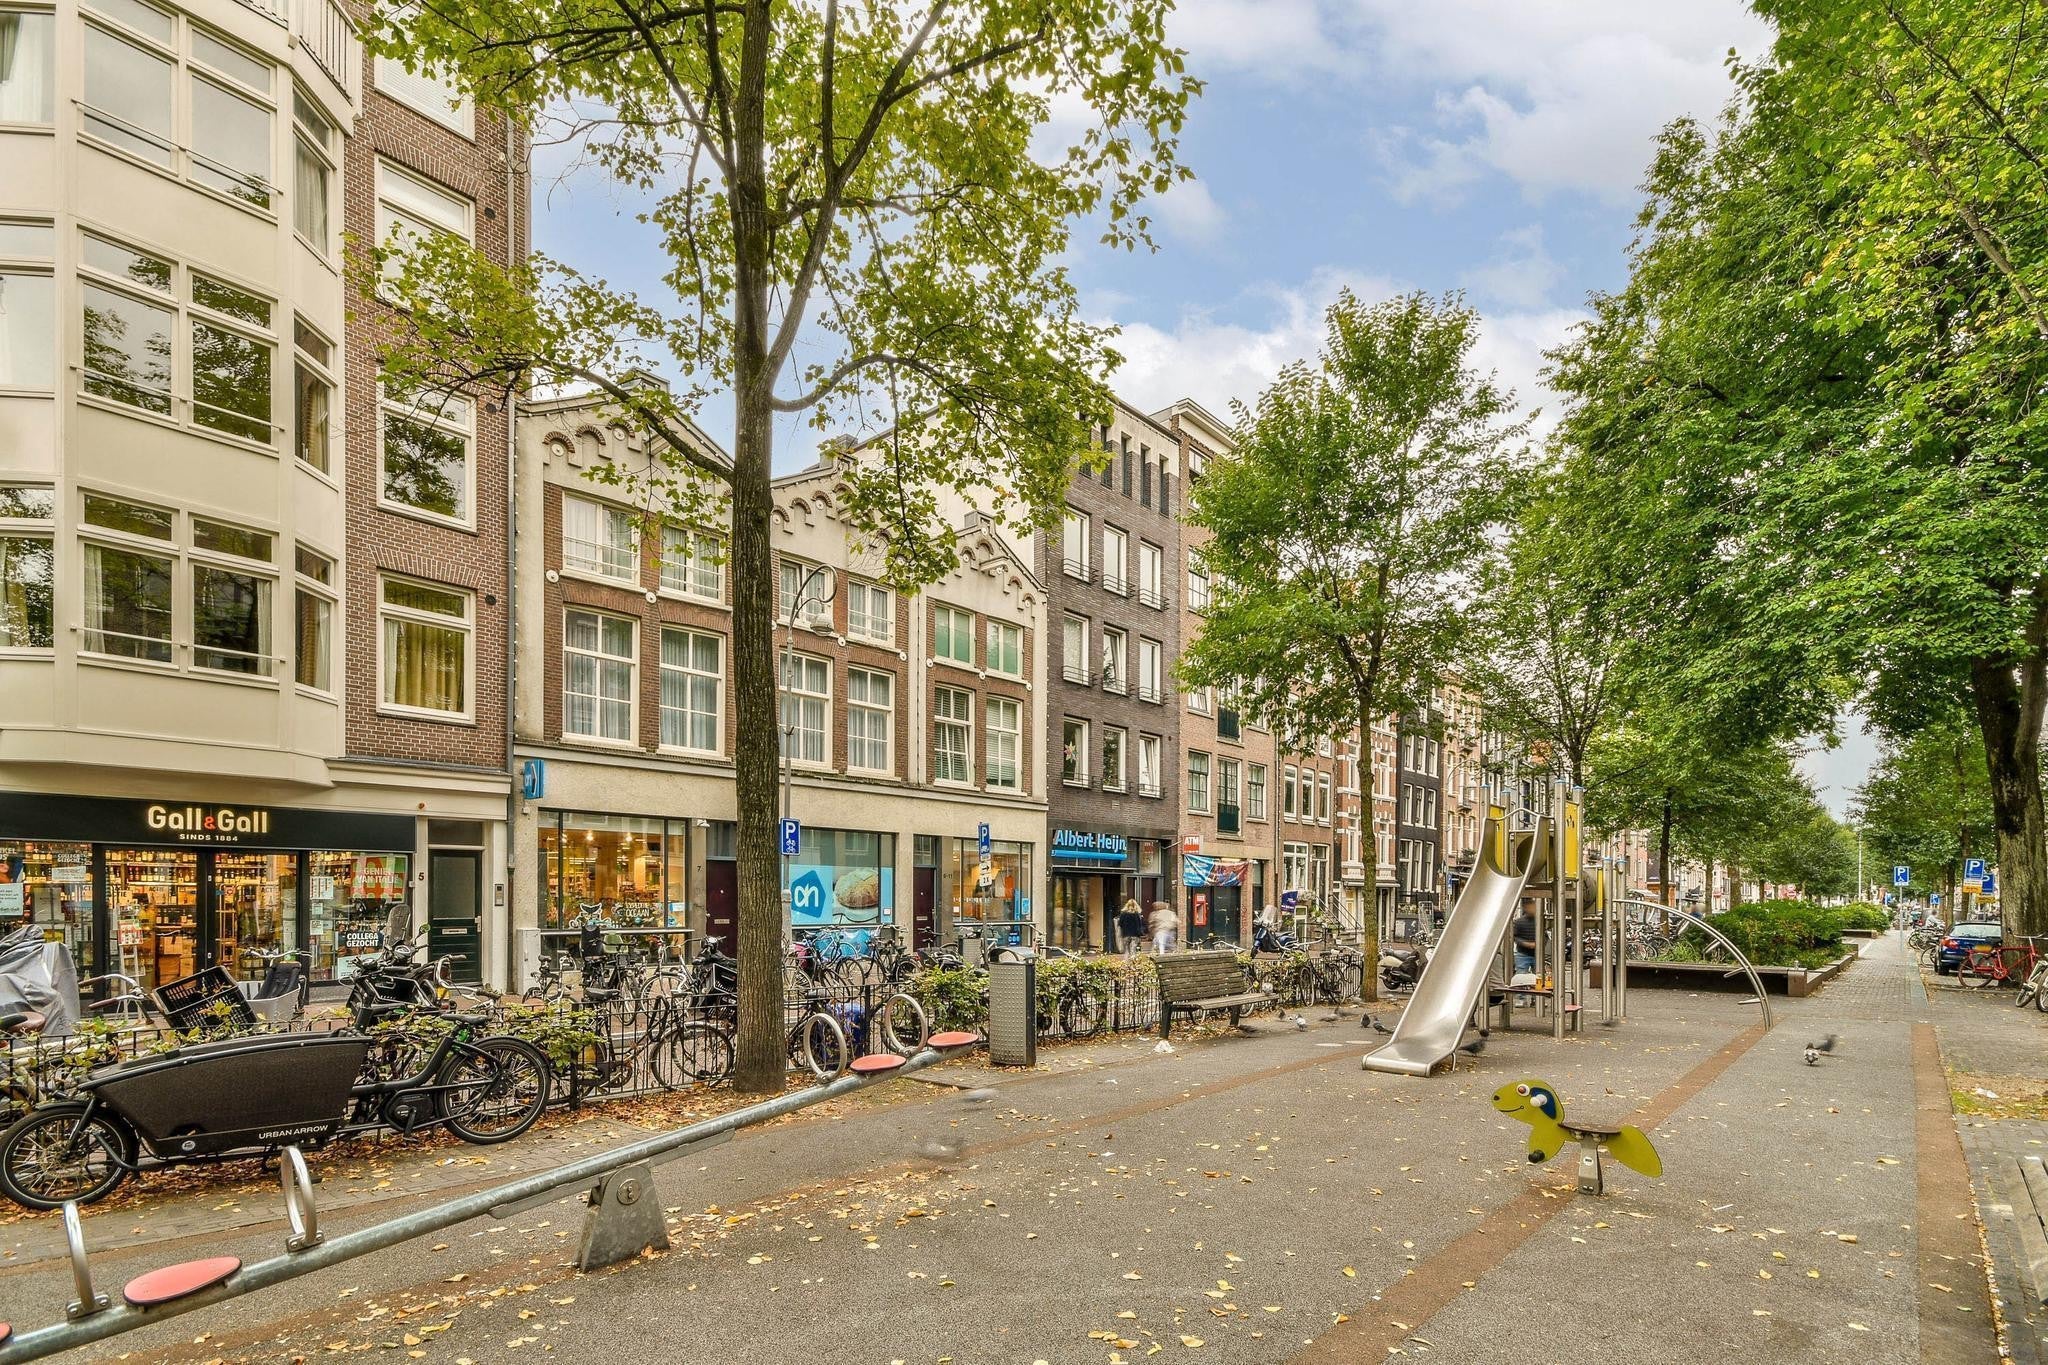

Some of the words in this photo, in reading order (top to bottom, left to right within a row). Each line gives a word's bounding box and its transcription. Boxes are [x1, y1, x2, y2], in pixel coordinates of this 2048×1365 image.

[147, 805, 202, 830] Gall
[217, 809, 268, 833] Gall
[785, 822, 796, 839] P
[981, 826, 988, 843] P
[179, 833, 211, 841] SINDS
[1052, 829, 1095, 848] Albert
[1096, 833, 1127, 853] Heijn
[1184, 836, 1199, 845] ATM
[1970, 861, 1980, 871] P
[418, 872, 425, 881] 5
[1898, 868, 1905, 876] P
[346, 932, 379, 940] COLLEGA
[346, 940, 379, 948] GEZOCHT
[258, 1130, 292, 1139] URBAN
[293, 1125, 328, 1134] ARROW
